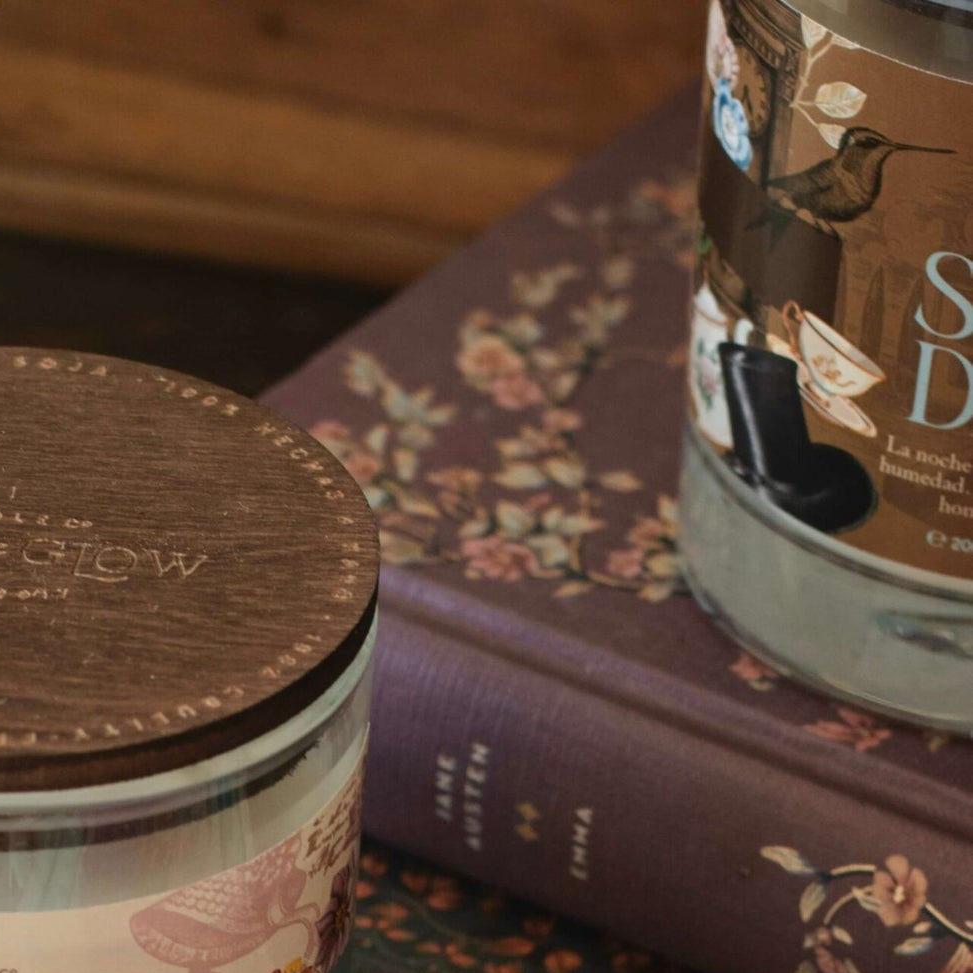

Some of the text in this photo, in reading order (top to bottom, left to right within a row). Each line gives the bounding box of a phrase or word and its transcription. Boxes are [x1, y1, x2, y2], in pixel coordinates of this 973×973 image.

[914, 251, 973, 340] S
[906, 340, 973, 430] D
[878, 455, 970, 496] humedad.
[887, 434, 973, 475] La noche
[950, 536, 973, 553] 20
[434, 753, 457, 823] JANE
[463, 741, 490, 852] AUSTEN
[568, 806, 594, 882] EMMA
